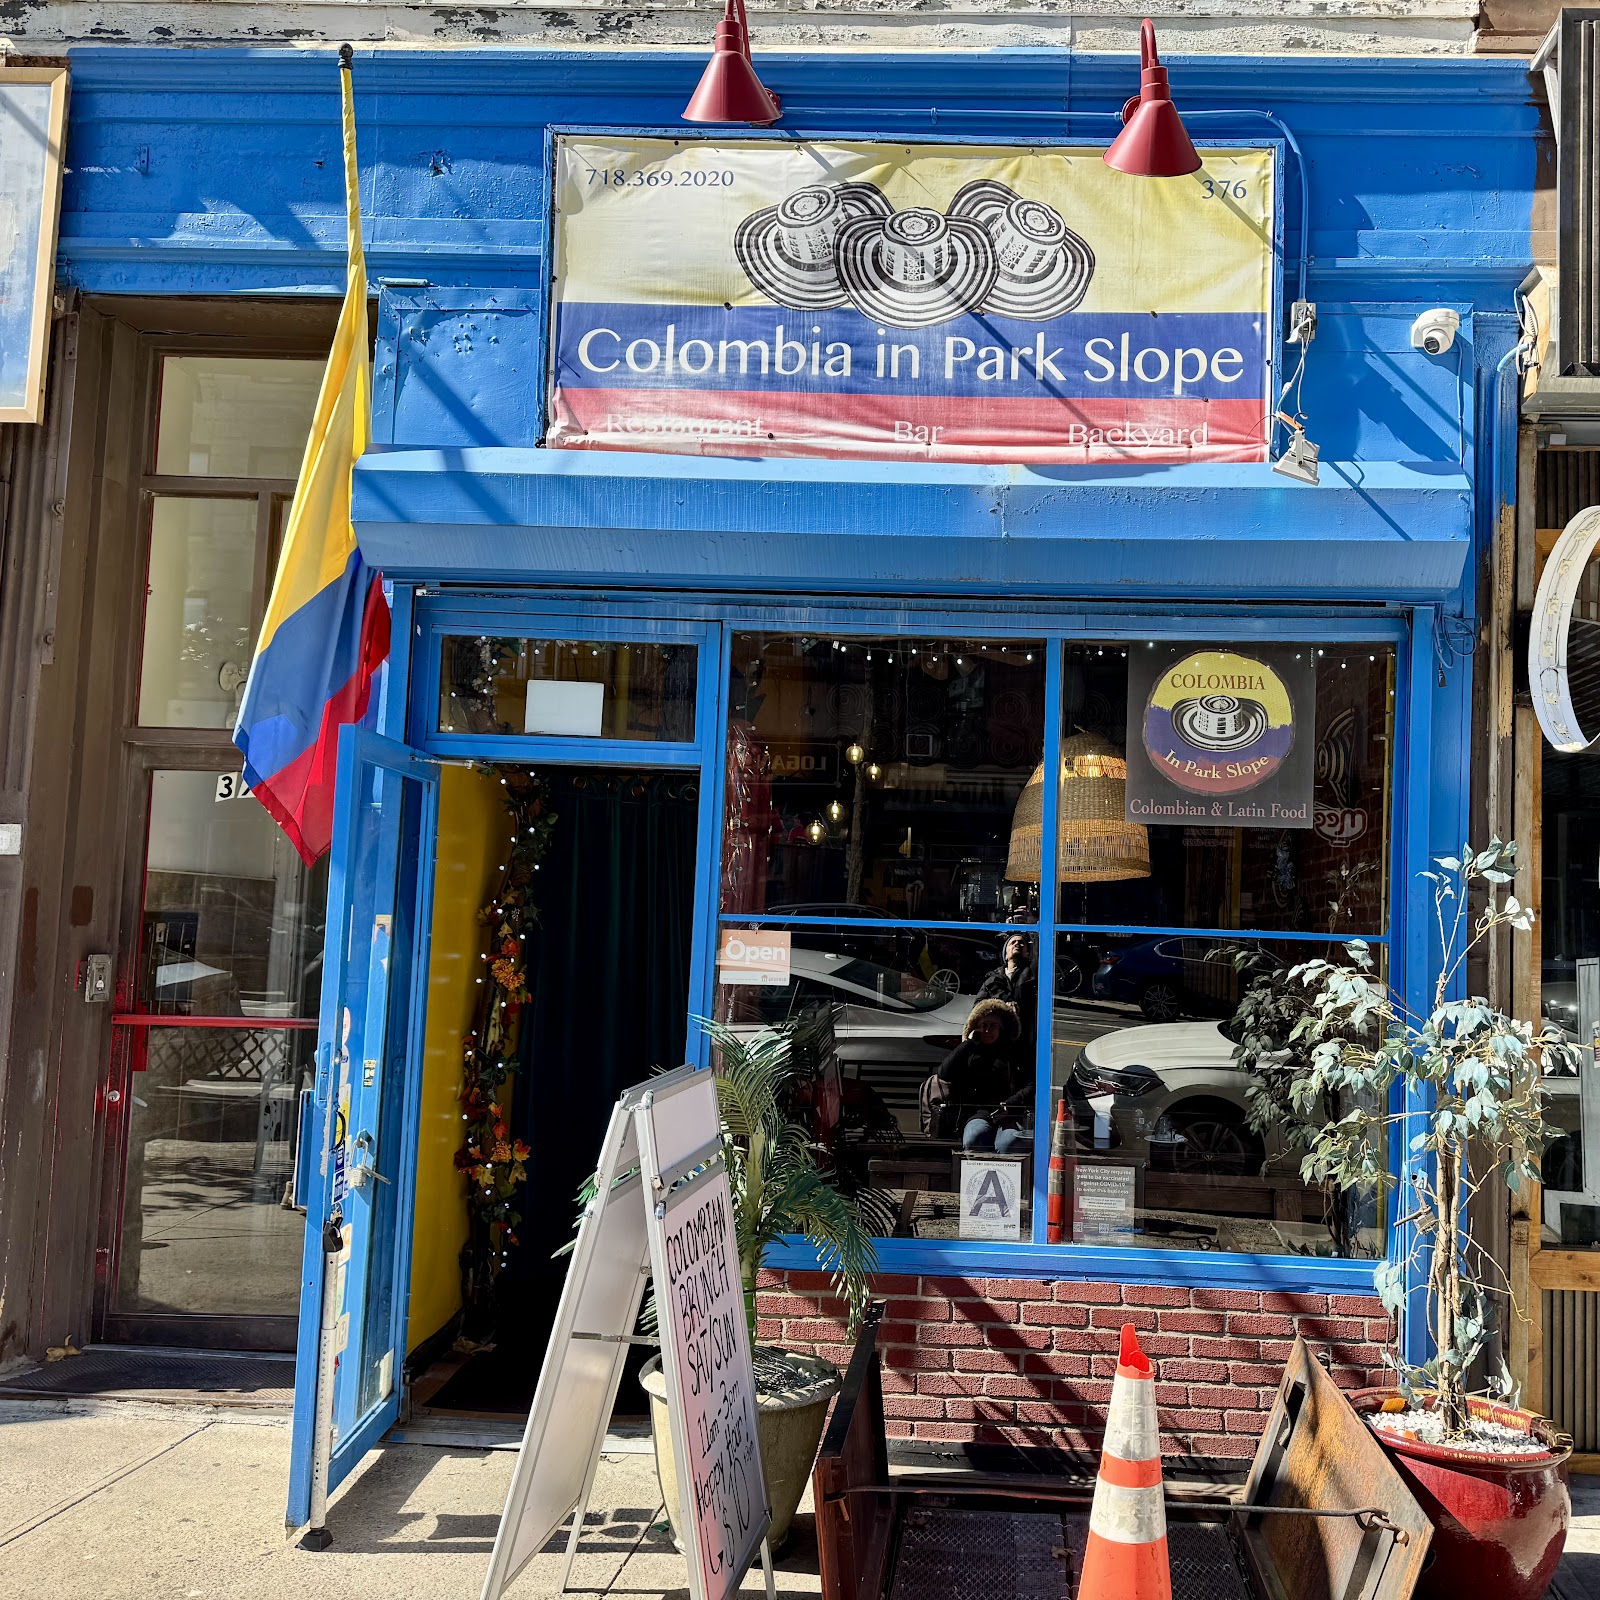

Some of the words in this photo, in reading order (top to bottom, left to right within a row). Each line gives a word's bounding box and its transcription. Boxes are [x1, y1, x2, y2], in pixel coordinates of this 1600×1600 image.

[585, 168, 735, 188] 718.369.2020
[1201, 178, 1247, 200] 376
[578, 323, 851, 379] Colombia
[876, 328, 919, 380] in
[944, 331, 1067, 382] Park
[1083, 331, 1244, 396] Slope
[607, 413, 764, 437] Restaurant
[894, 420, 943, 443] Bar
[1068, 421, 1209, 447] Backyard
[1171, 673, 1266, 691] COLOMBIA
[1163, 749, 1181, 769] In
[1185, 760, 1222, 780] Park
[1226, 755, 1269, 779] Slope
[1130, 799, 1206, 816] Colombian
[1211, 802, 1223, 816] &
[1228, 802, 1266, 817] Latin
[1270, 803, 1307, 819] Food
[725, 939, 786, 966] Open
[969, 1170, 1011, 1218] A
[665, 1191, 727, 1286] COLOMBIAN
[678, 1244, 731, 1343] BRUNCH
[687, 1307, 737, 1397] SAT/SUN
[694, 1448, 727, 1523] Happy
